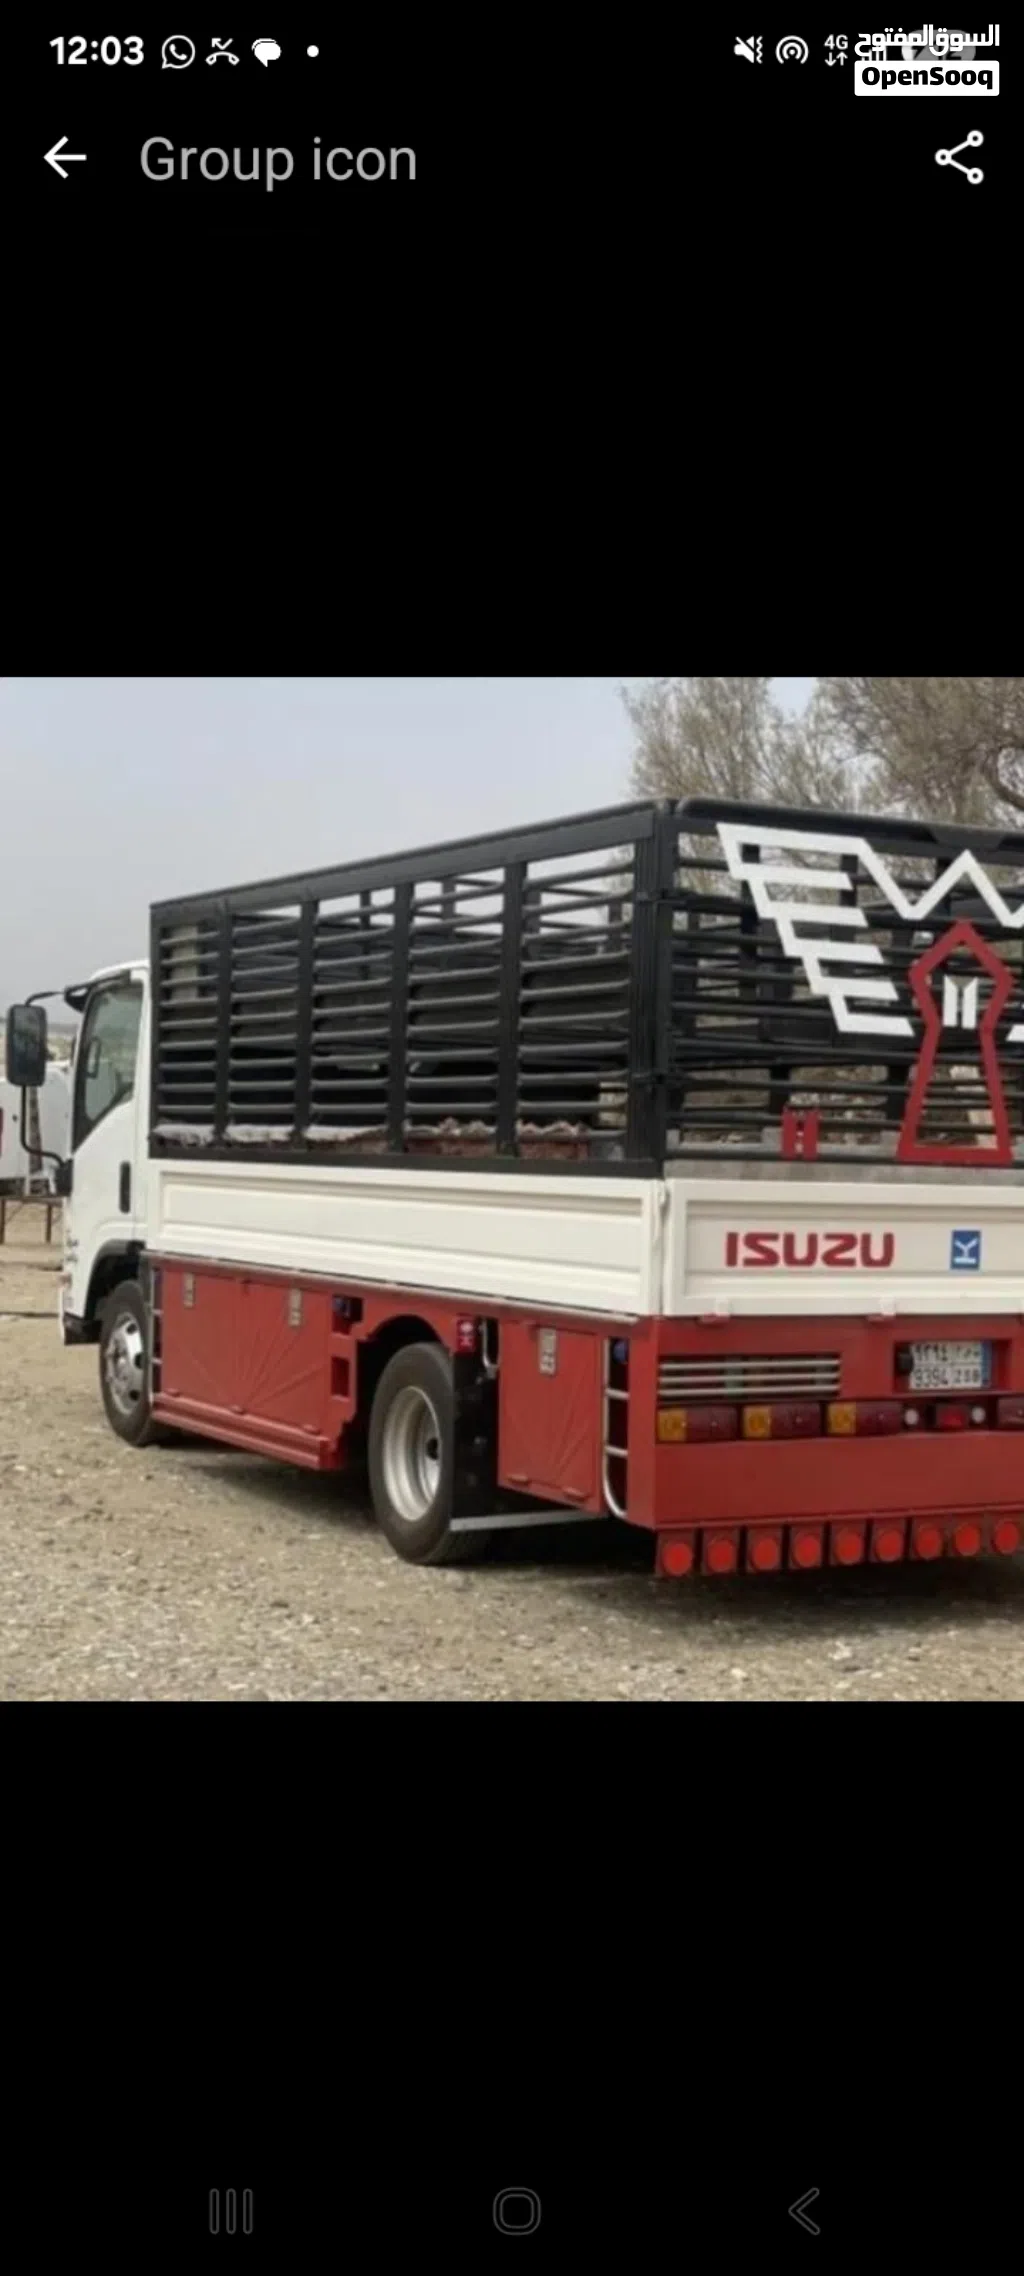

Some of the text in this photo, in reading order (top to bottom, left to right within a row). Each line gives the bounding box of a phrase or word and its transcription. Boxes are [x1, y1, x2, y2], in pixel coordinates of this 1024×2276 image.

[49, 35, 145, 66] 12:03
[823, 33, 849, 51] 4G
[140, 136, 418, 192] Group icon
[725, 1231, 895, 1268] ISUZU
